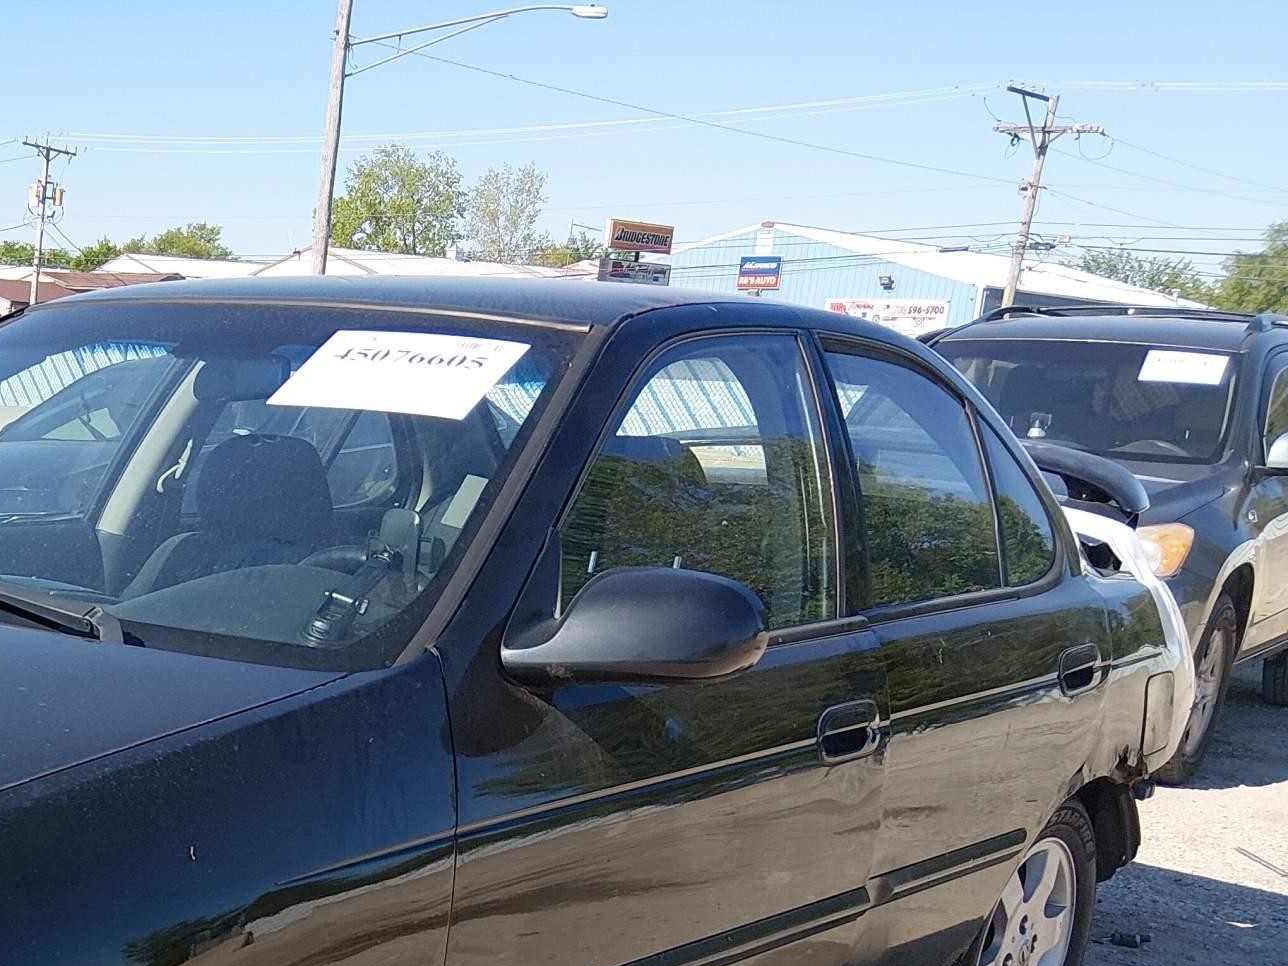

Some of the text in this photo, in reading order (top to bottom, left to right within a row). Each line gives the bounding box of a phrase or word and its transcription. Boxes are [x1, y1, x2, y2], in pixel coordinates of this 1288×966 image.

[615, 227, 670, 247] BRIDGESTONE
[755, 276, 777, 285] AUTO
[907, 305, 945, 315] 596-5700
[334, 347, 489, 369] 45076605
